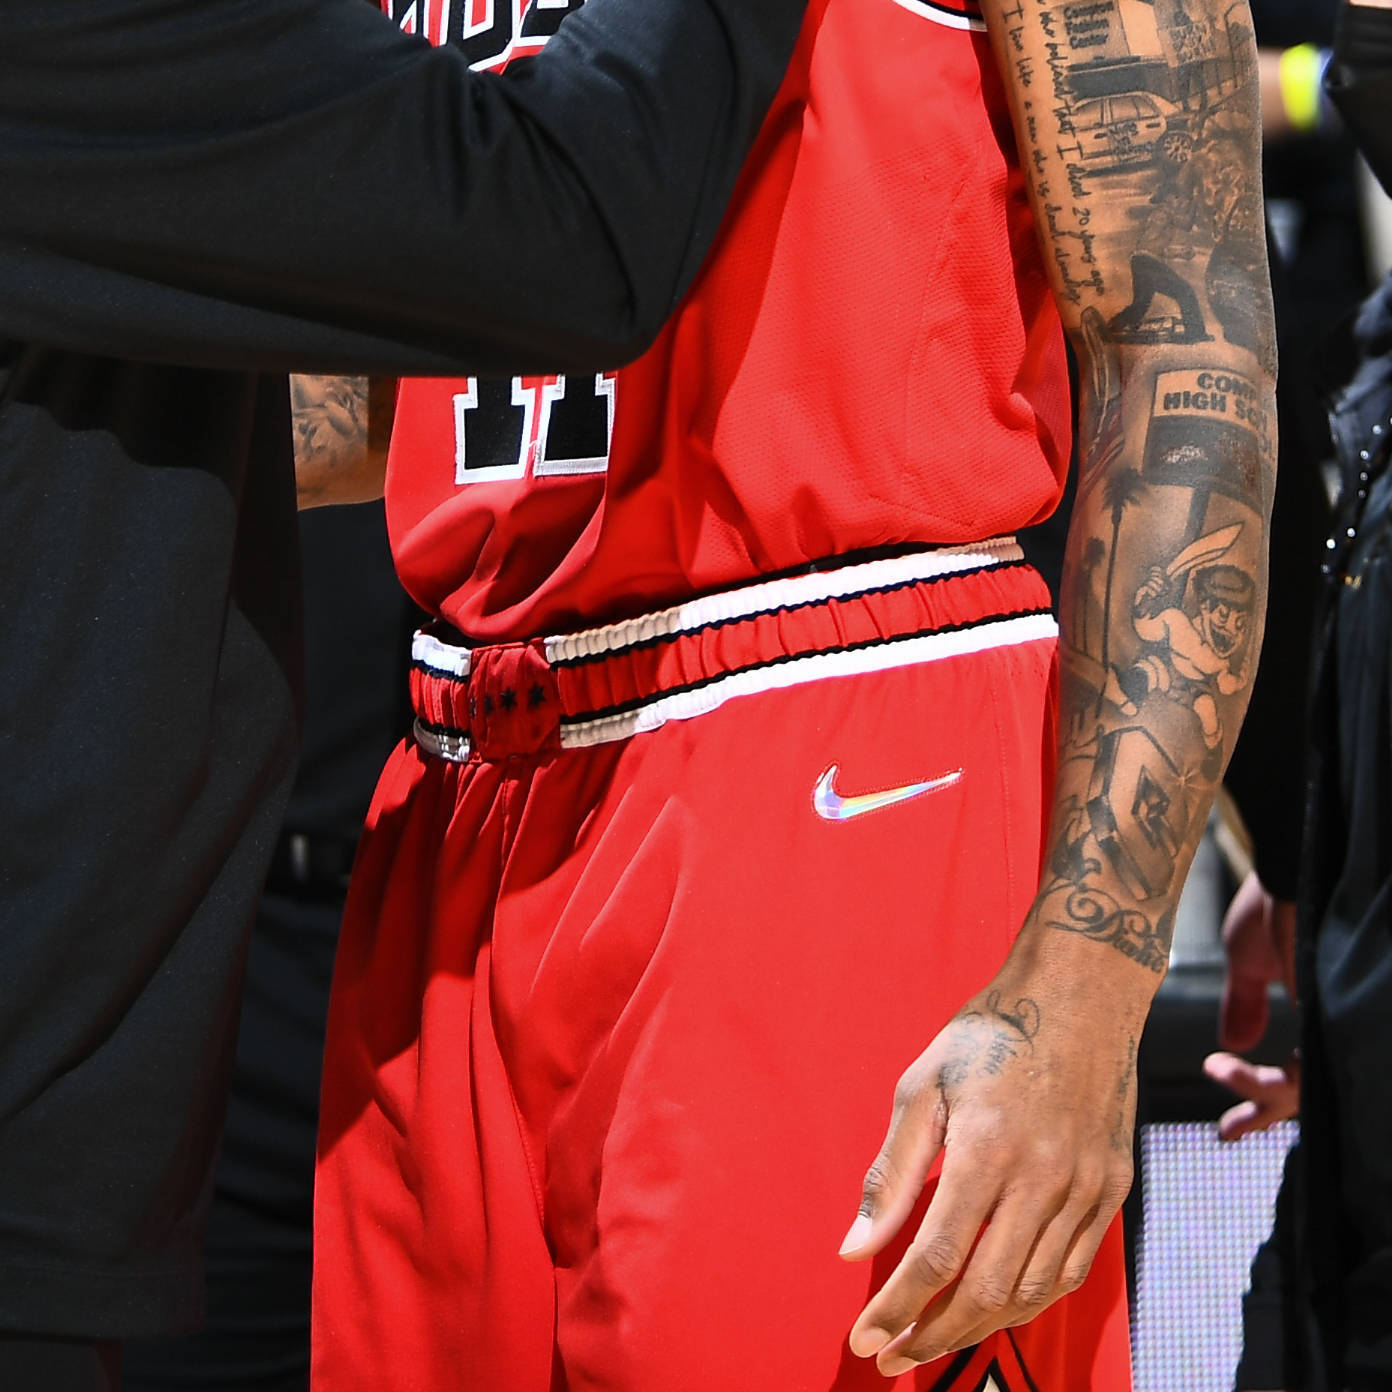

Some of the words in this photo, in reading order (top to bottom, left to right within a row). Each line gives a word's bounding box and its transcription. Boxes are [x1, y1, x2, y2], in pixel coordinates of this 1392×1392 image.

[1002, 0, 1024, 24] I
[1056, 140, 1083, 160] I
[1072, 207, 1090, 226] 20
[1163, 390, 1226, 412] HIGH
